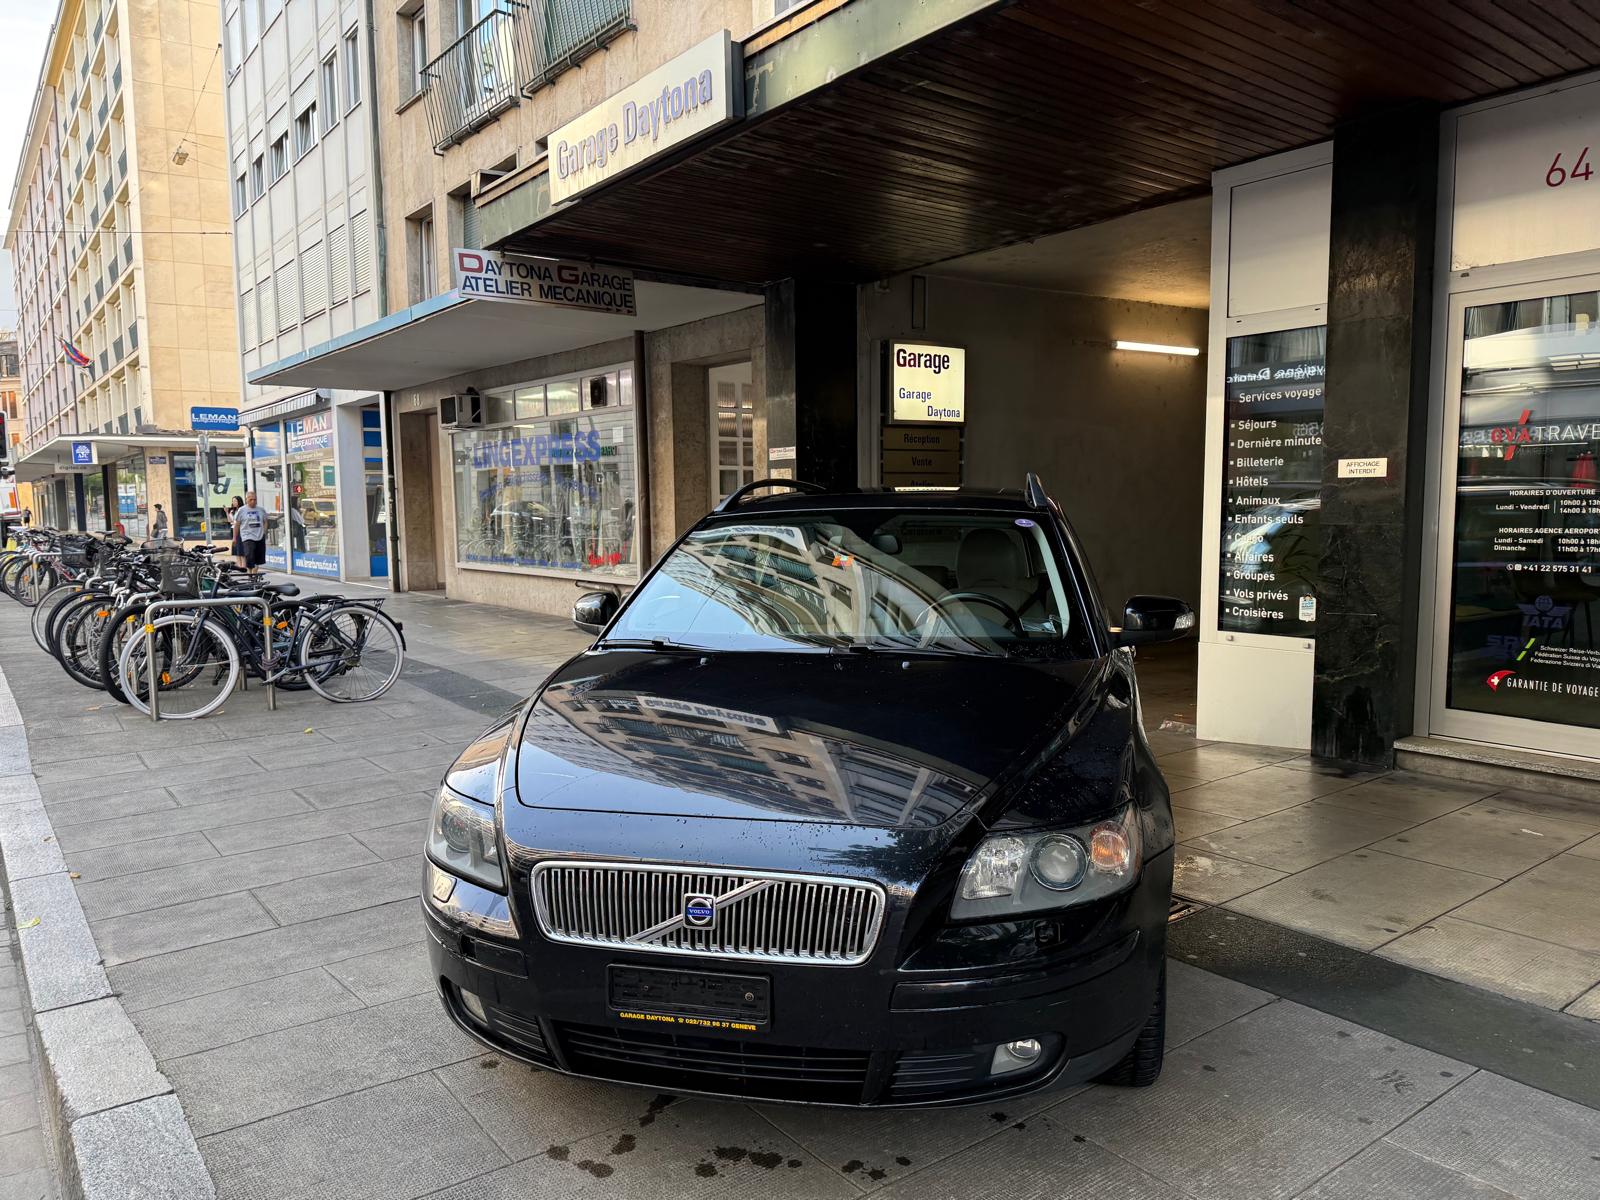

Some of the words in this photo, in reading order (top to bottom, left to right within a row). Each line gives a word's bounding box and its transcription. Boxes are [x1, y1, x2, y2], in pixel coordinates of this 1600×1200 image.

[556, 122, 619, 180] Garage
[623, 69, 713, 145] Daytona
[1546, 147, 1594, 187] 64
[458, 252, 553, 282] DAYTONA
[557, 265, 633, 292] GARAGE
[462, 275, 532, 297] ATELIER
[539, 283, 634, 309] MECANIQUE
[896, 348, 950, 374] Garage
[899, 387, 932, 403] Garage
[1239, 391, 1282, 403] Services
[1285, 388, 1322, 400] voyage
[927, 405, 961, 419] Daytona
[291, 415, 327, 440] LEMAN
[1238, 420, 1277, 431] Séjours
[1237, 436, 1282, 449] Dernière
[1285, 435, 1322, 446] minute
[912, 456, 932, 467] Vente
[1236, 456, 1284, 468] Billeterie
[1236, 476, 1269, 487] Hôtels
[1236, 495, 1280, 505] Animaux
[1235, 514, 1273, 524] Enfants
[1276, 514, 1304, 524] seuls
[1234, 551, 1274, 562] Affaires
[1540, 564, 1550, 572] 22
[1233, 570, 1275, 582] Groupes
[1233, 588, 1254, 598] Vols
[1256, 590, 1289, 602] privés
[1232, 606, 1284, 619] Croisières
[1522, 614, 1563, 628] IATA
[1506, 677, 1548, 692] GARANTIE
[1552, 683, 1562, 693] DE
[1566, 684, 1599, 698] VOYAGE
[620, 1012, 645, 1020] GARAGE
[646, 1014, 675, 1022] DAYTONA
